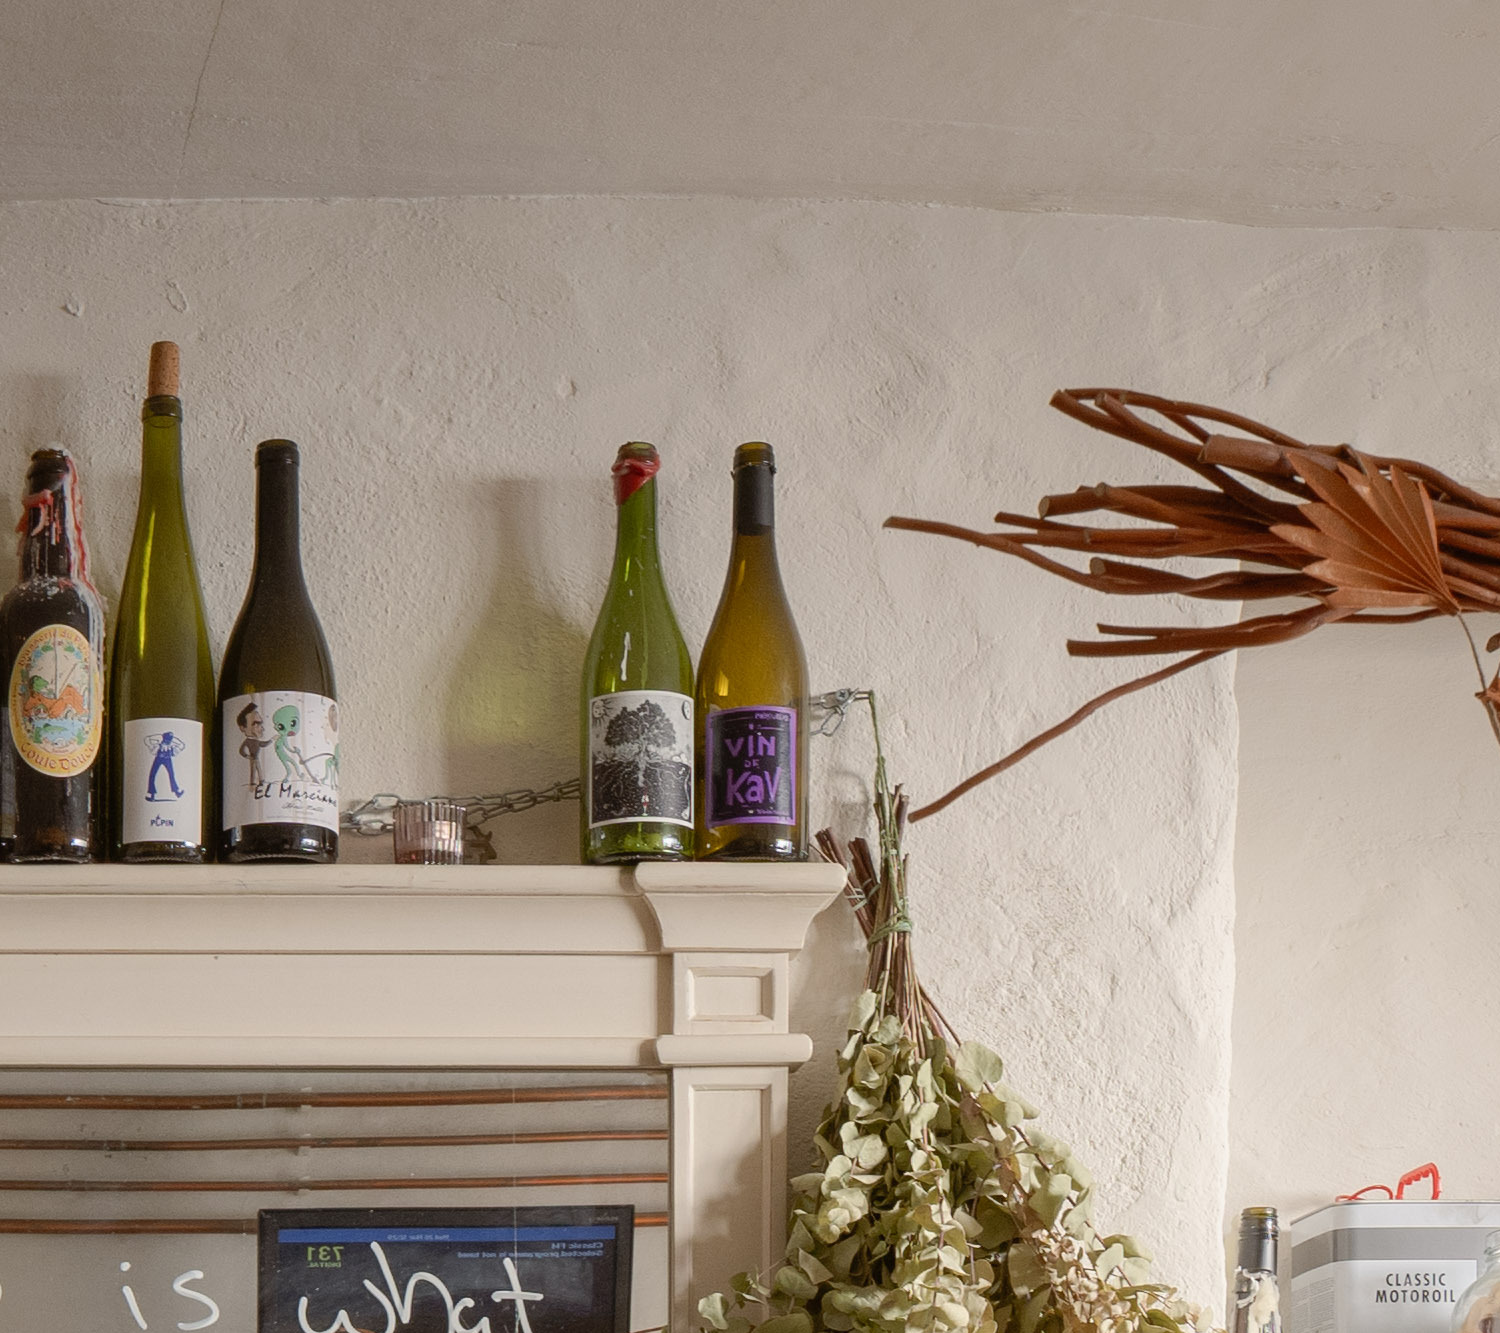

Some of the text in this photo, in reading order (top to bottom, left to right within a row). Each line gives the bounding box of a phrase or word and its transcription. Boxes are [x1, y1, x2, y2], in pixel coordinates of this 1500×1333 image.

[255, 783, 271, 799] El
[1386, 1273, 1446, 1287] CLASSIC
[119, 1261, 221, 1332] is
[1375, 1290, 1456, 1304] MOTOROIL
